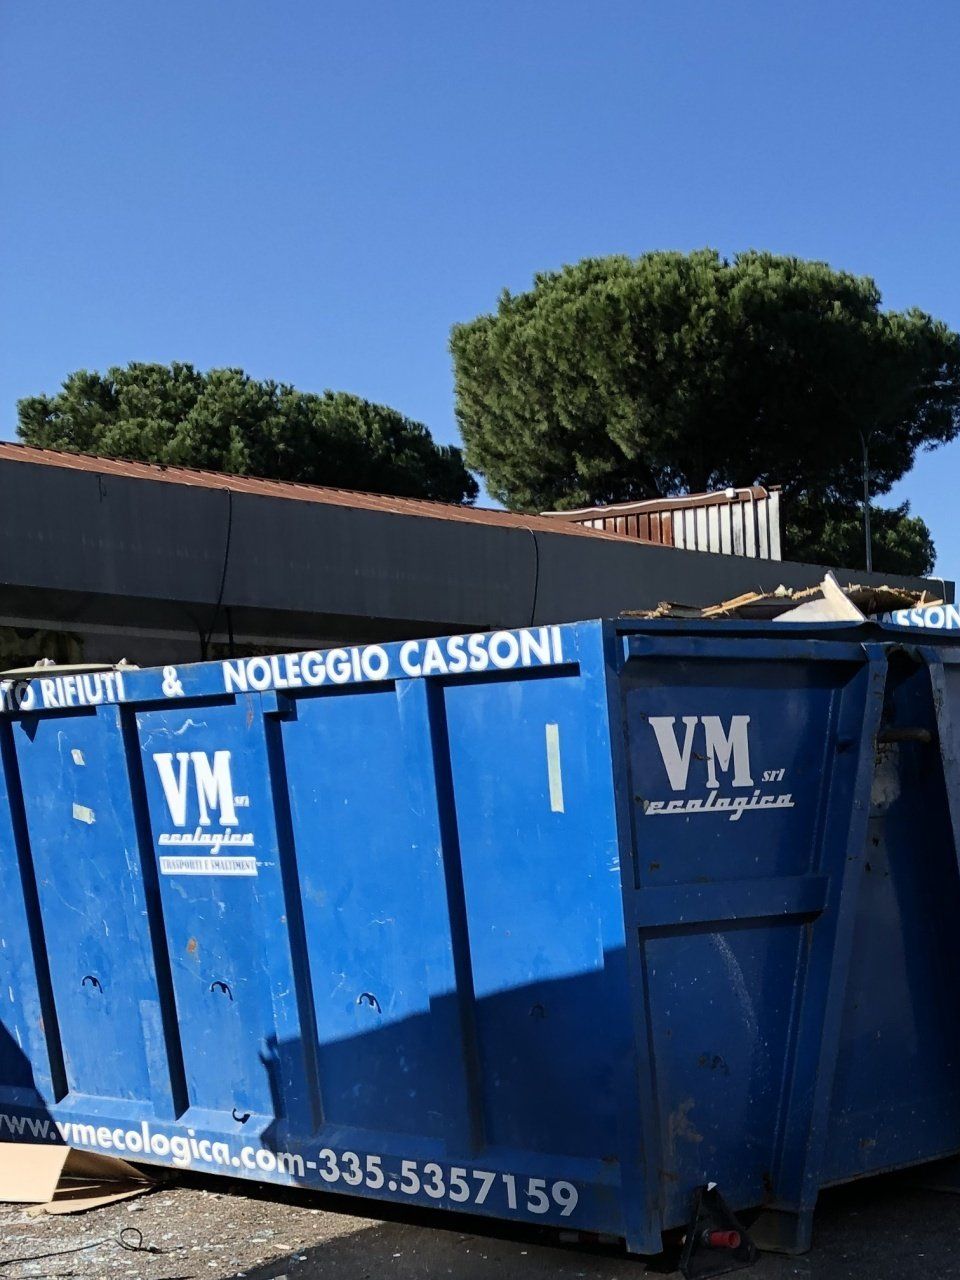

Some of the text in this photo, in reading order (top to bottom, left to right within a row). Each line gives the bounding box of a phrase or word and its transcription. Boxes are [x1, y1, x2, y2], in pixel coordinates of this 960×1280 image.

[40, 671, 126, 708] RIFIUTI
[162, 666, 185, 697] &
[222, 645, 389, 693] NOLEGGIO
[399, 626, 564, 676] CASSONI
[153, 750, 239, 827] VM
[648, 715, 785, 791] VM srl
[158, 827, 254, 855] ecologica
[645, 790, 795, 821] ecologica
